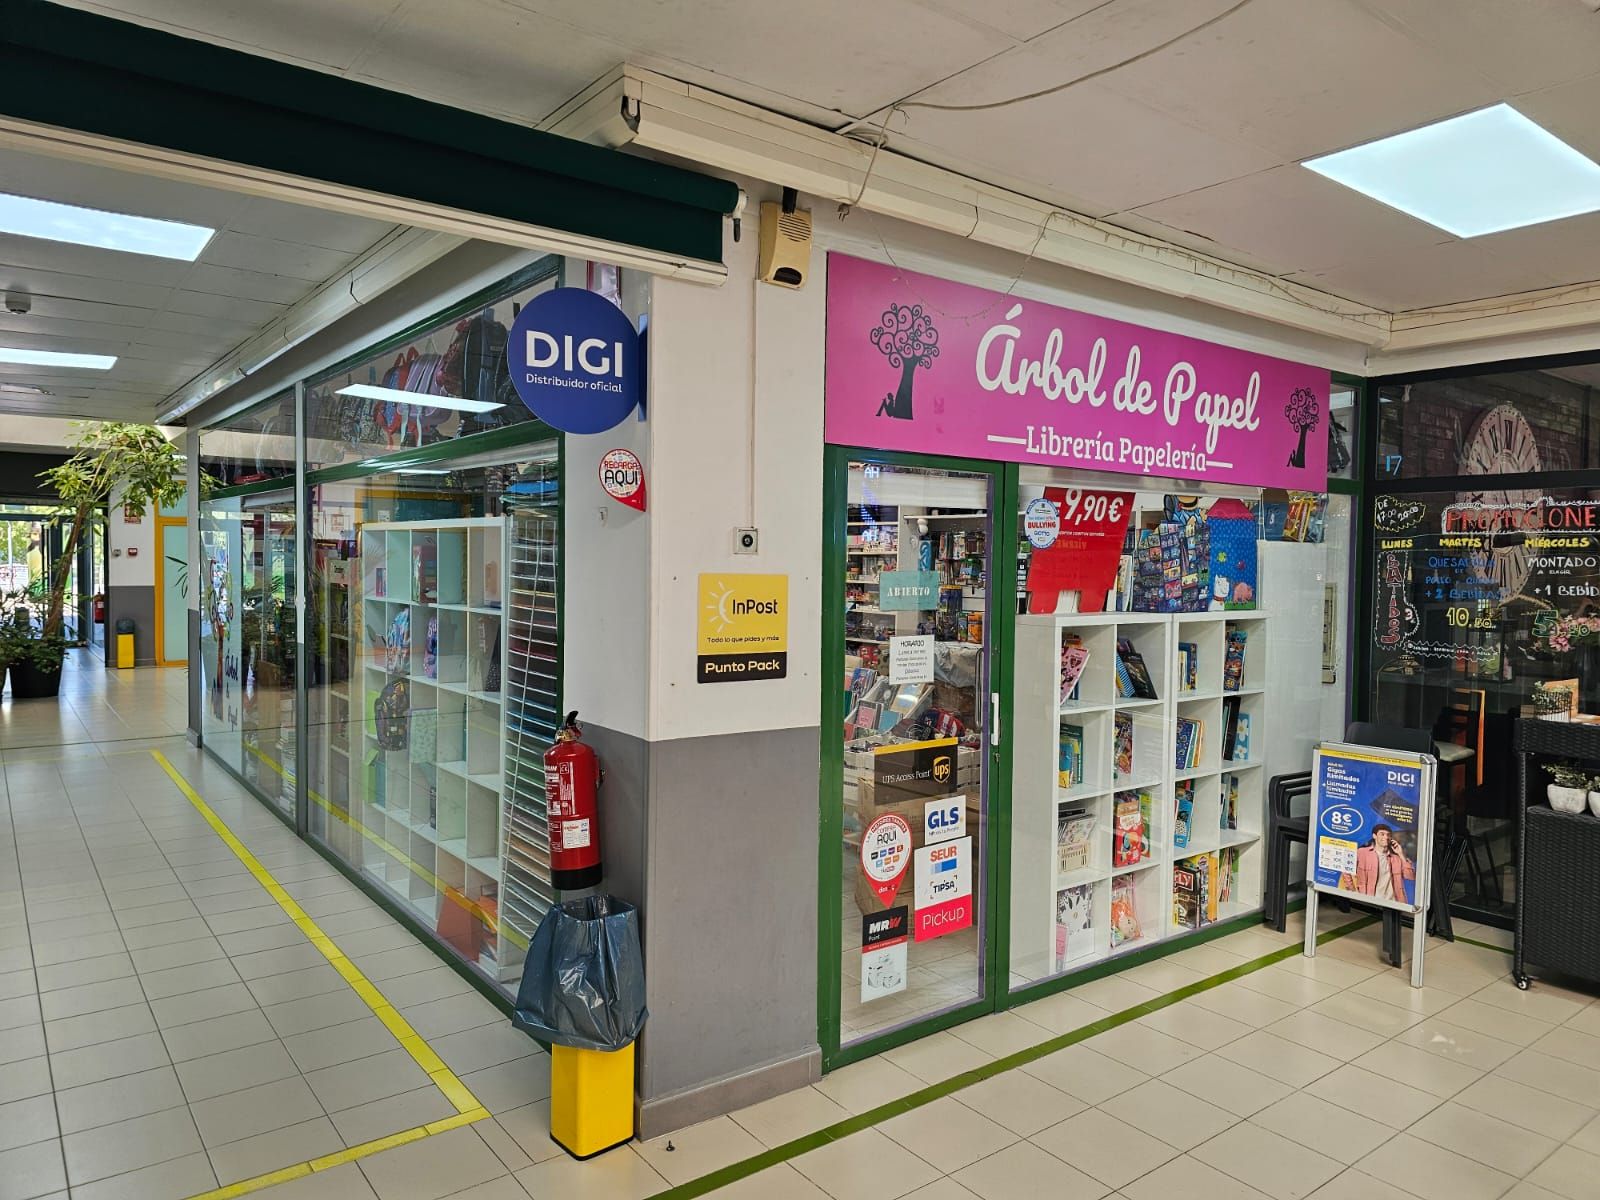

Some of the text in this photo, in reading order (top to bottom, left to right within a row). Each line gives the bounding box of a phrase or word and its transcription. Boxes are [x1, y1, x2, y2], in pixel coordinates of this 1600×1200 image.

[526, 330, 623, 378] DIGI
[526, 373, 622, 393] Distribuidor oficial
[975, 303, 1260, 454] Árbol de Papel
[1026, 425, 1206, 473] Librería Papelería
[1385, 456, 1402, 476] 17
[604, 470, 638, 487] AQUI
[1378, 499, 1388, 510] DE
[1027, 521, 1057, 529] BULLYING
[1382, 539, 1413, 549] LUNES
[1439, 538, 1482, 548] MARTES
[1524, 536, 1591, 549] MIÉRCOLES
[1528, 556, 1597, 568] MONTADO
[887, 586, 930, 597] ABIERTO
[1436, 589, 1443, 599] 2
[1545, 584, 1551, 596] 1
[732, 599, 778, 615] InPost
[705, 659, 780, 673] Punto Pack
[882, 769, 930, 784] UPS Access Point
[934, 764, 949, 779] ups
[1387, 771, 1415, 784] DIGI
[927, 806, 959, 830] GLS
[876, 830, 897, 846] AQUI
[929, 846, 957, 863] SEUR
[869, 916, 902, 934] MRW
[922, 907, 965, 931] Pickup
